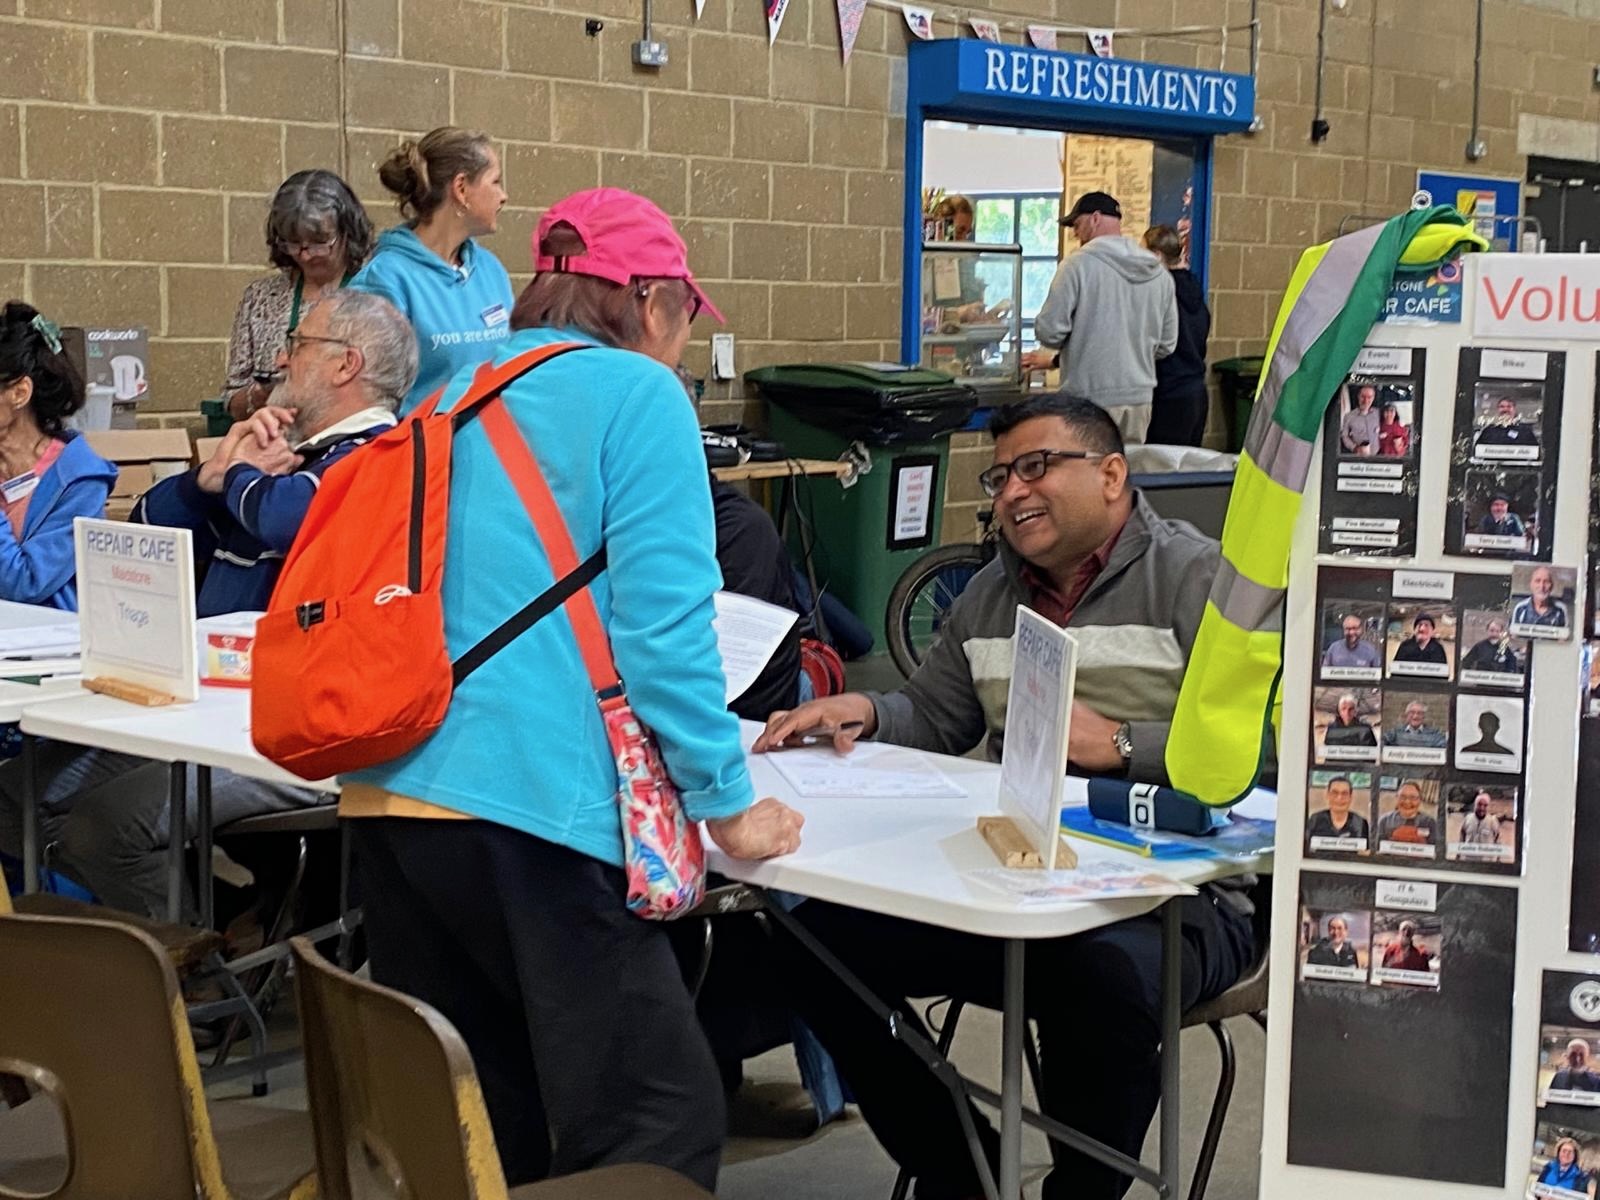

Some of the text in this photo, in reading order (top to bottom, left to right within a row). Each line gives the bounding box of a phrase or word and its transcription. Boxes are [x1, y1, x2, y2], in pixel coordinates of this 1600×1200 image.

[984, 48, 1238, 117] REFRESHMENTS
[1404, 297, 1452, 314] CAFE
[1482, 275, 1600, 323] Volu
[431, 332, 461, 351] you
[463, 329, 482, 343] are
[1502, 359, 1525, 368] Bikes
[87, 530, 175, 562] REPAIR CAFE
[1383, 894, 1428, 907] Computers
